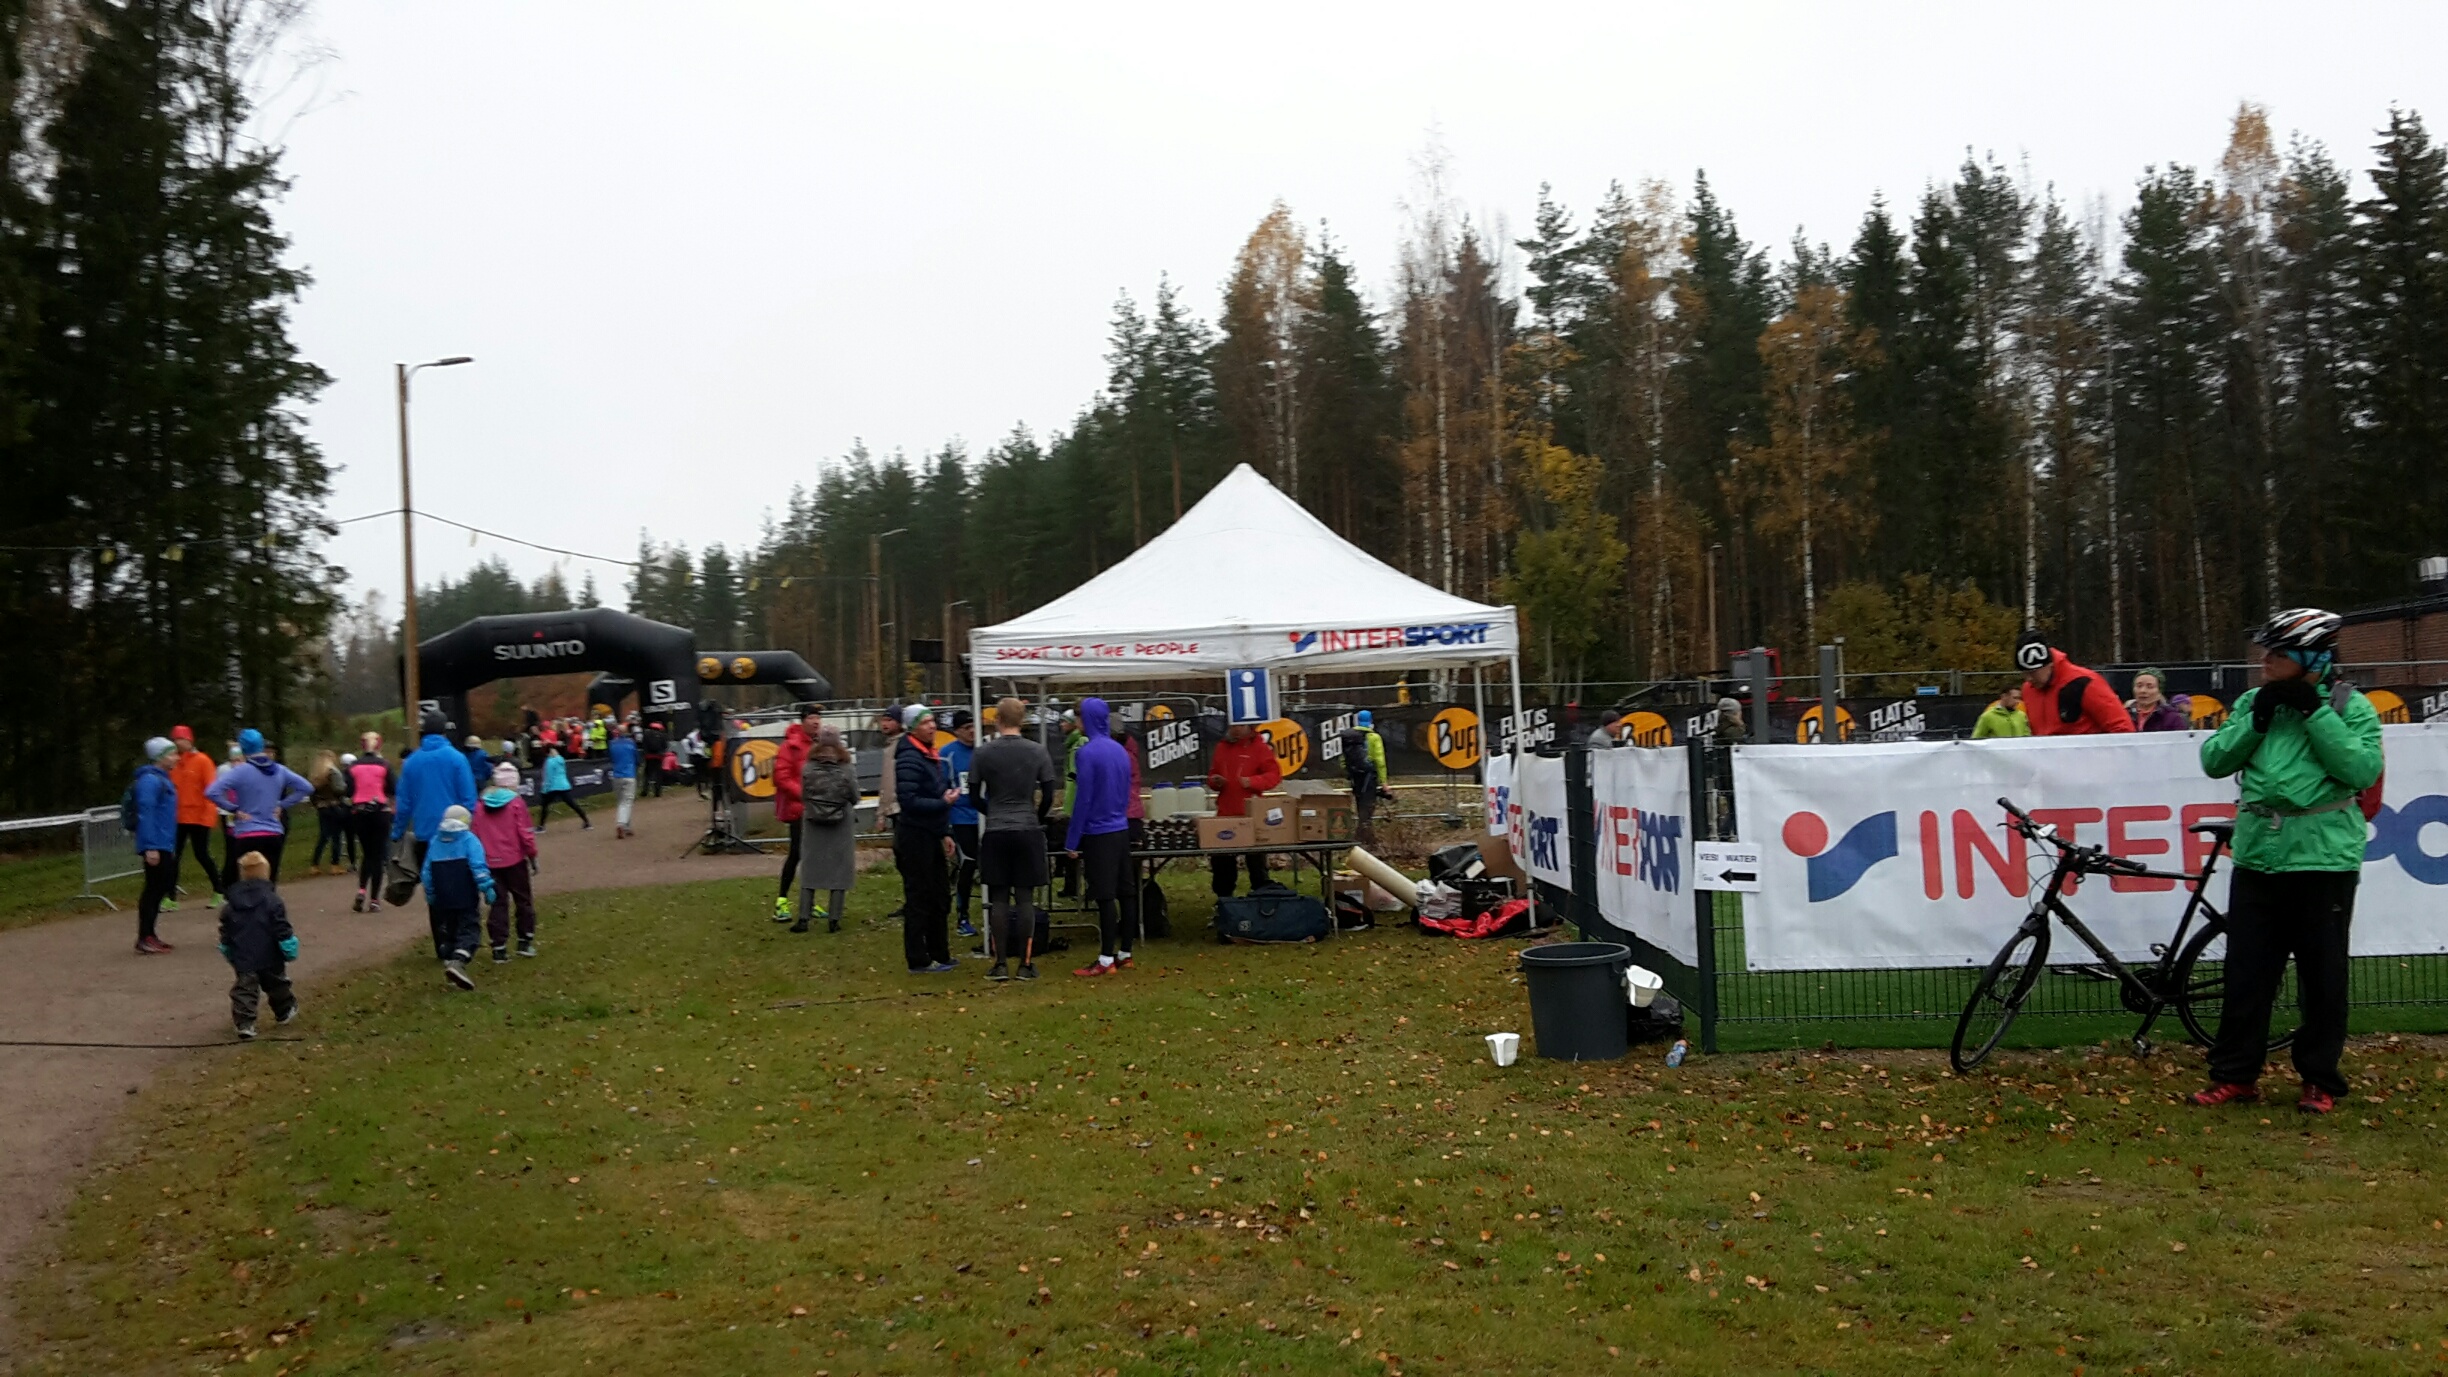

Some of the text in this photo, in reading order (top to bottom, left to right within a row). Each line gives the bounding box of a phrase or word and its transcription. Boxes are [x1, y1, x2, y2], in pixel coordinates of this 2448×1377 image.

[1321, 623, 1489, 652] INTERSPORT
[494, 640, 585, 660] SUUNTO
[996, 642, 1200, 661] SPORT TO THE PEOPLE
[1870, 701, 1902, 730] FLAT
[1147, 720, 1191, 749] FLAT IS
[1725, 854, 1757, 863] WATER
